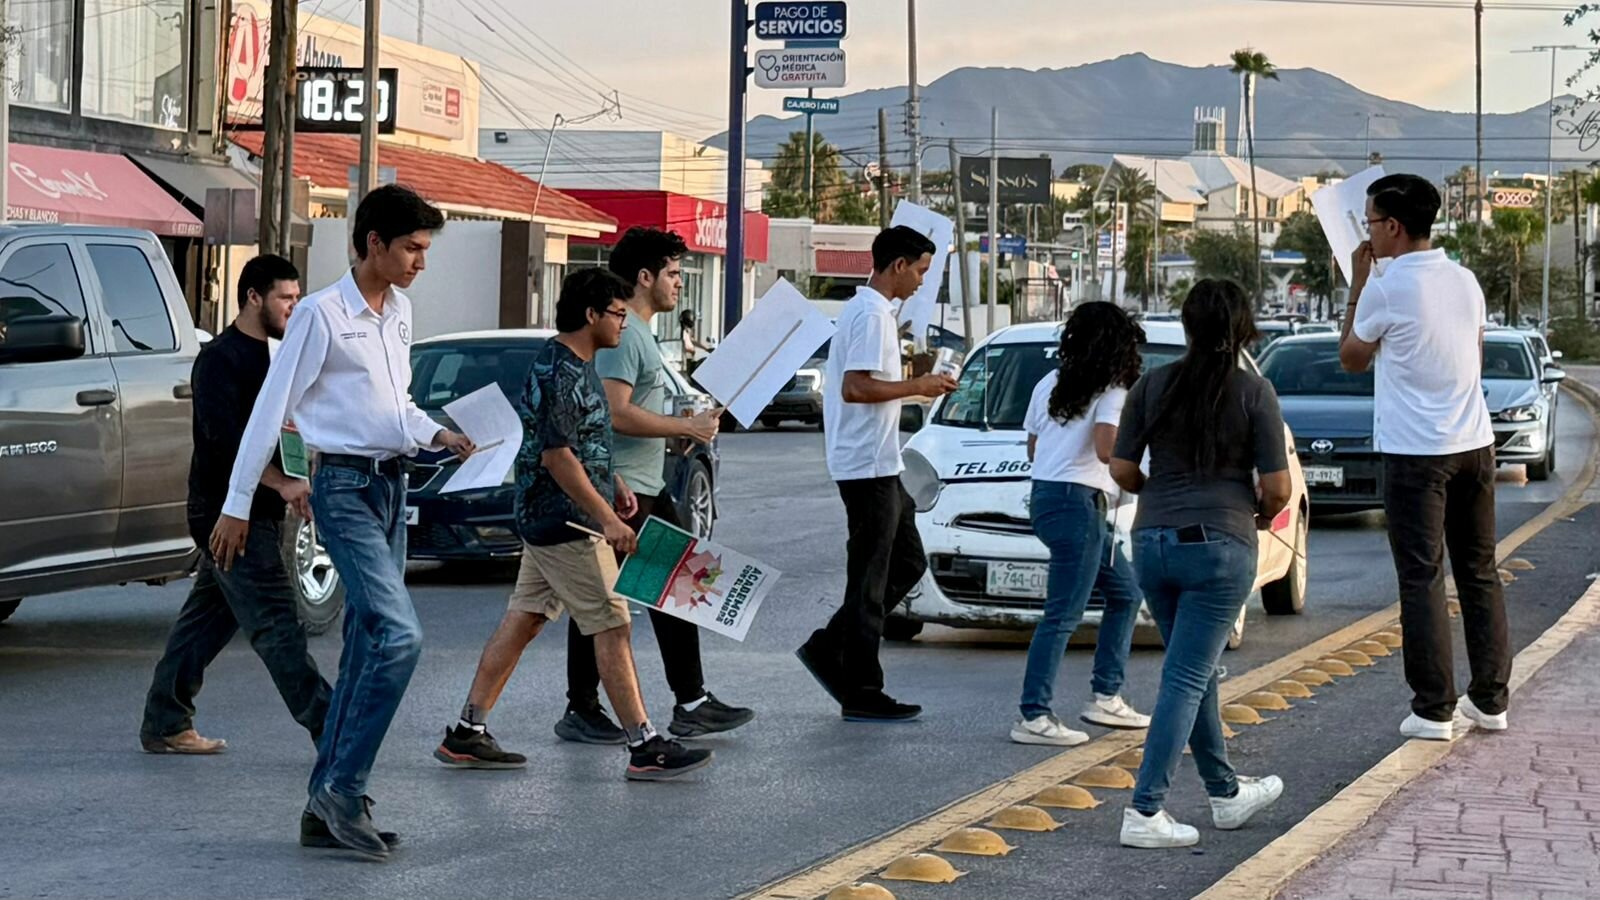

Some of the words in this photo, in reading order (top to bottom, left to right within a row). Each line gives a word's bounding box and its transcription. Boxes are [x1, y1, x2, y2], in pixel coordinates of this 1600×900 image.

[774, 6, 809, 18] PAGO
[812, 6, 828, 18] DE
[758, 19, 844, 35] SERVICIOS
[782, 52, 844, 62] ORIENTACIÓN
[782, 62, 816, 72] MÉDICA
[296, 72, 364, 81] OLARE
[781, 72, 827, 81] GRATUITA
[786, 101, 817, 109] CAJERO
[821, 102, 837, 110] ATM
[1494, 191, 1532, 205] OXXO
